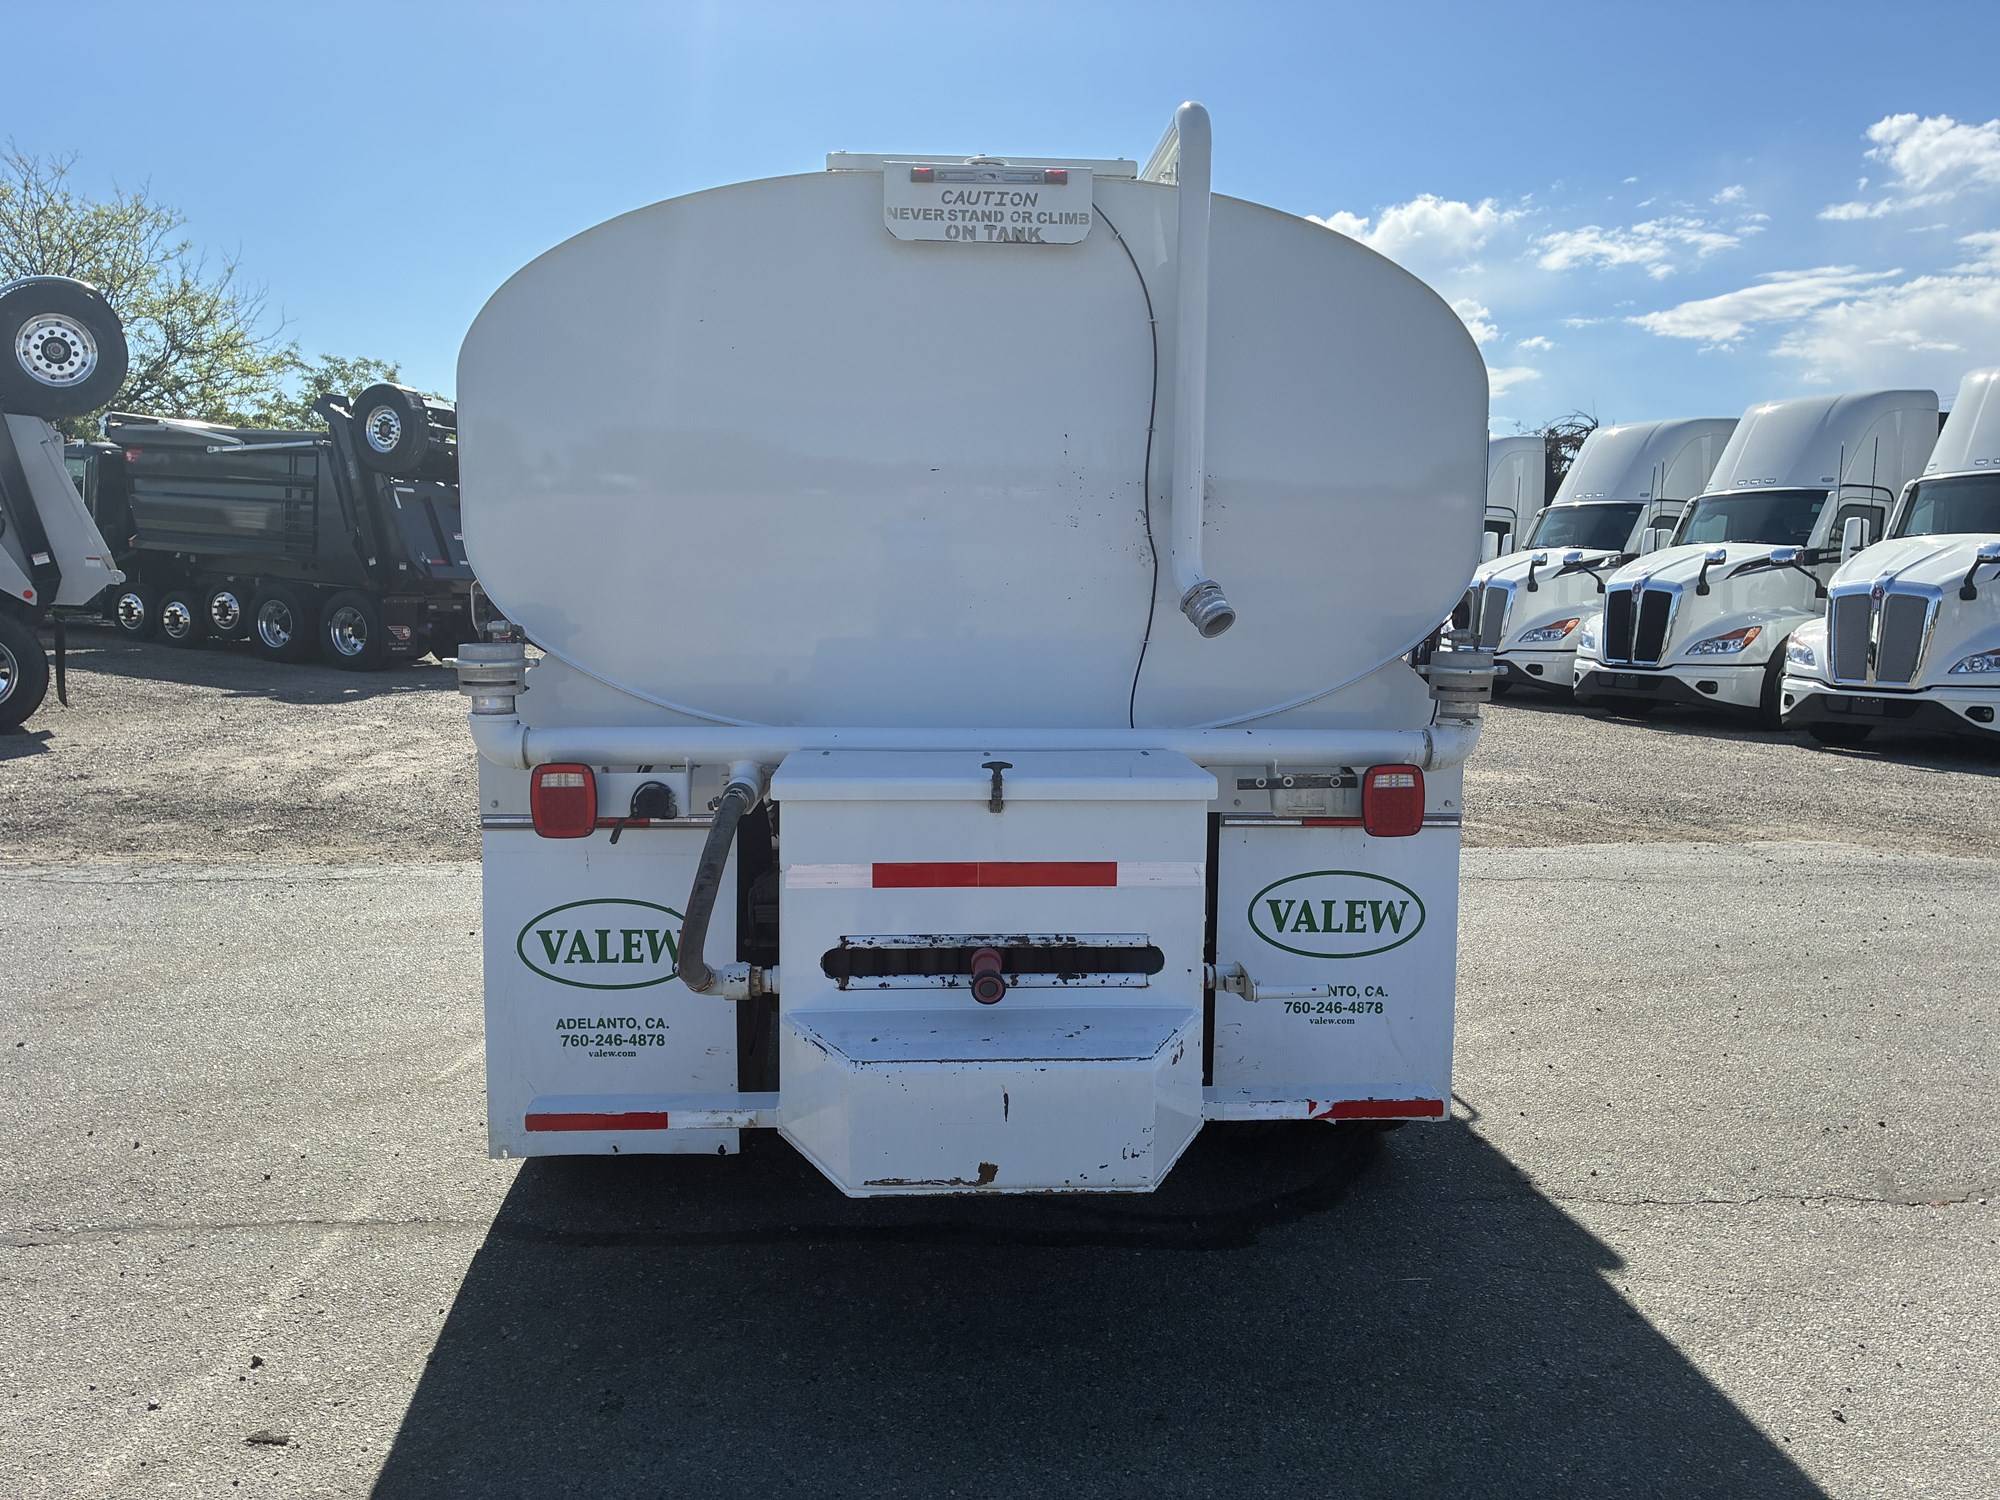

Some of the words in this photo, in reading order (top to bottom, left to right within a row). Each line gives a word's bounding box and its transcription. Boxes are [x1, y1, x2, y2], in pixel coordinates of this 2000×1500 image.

[941, 189, 1039, 207] CAUTION
[886, 206, 945, 221] NEVER
[947, 208, 1005, 223] STAND
[1010, 210, 1033, 223] OR
[1036, 211, 1090, 225] CLIMB
[945, 224, 977, 240] ON
[983, 224, 1042, 243] TANK
[1266, 899, 1410, 934] VALEW
[536, 929, 682, 965] VALEW
[1364, 985, 1389, 997] CA.
[1284, 1001, 1384, 1014] 760-246-4878
[555, 1017, 641, 1031] ADELANTO,
[645, 1017, 670, 1029] CA.
[1309, 1016, 1355, 1025] valew.com
[560, 1033, 666, 1047] 760-246-4878
[588, 1049, 637, 1058] valew.com
